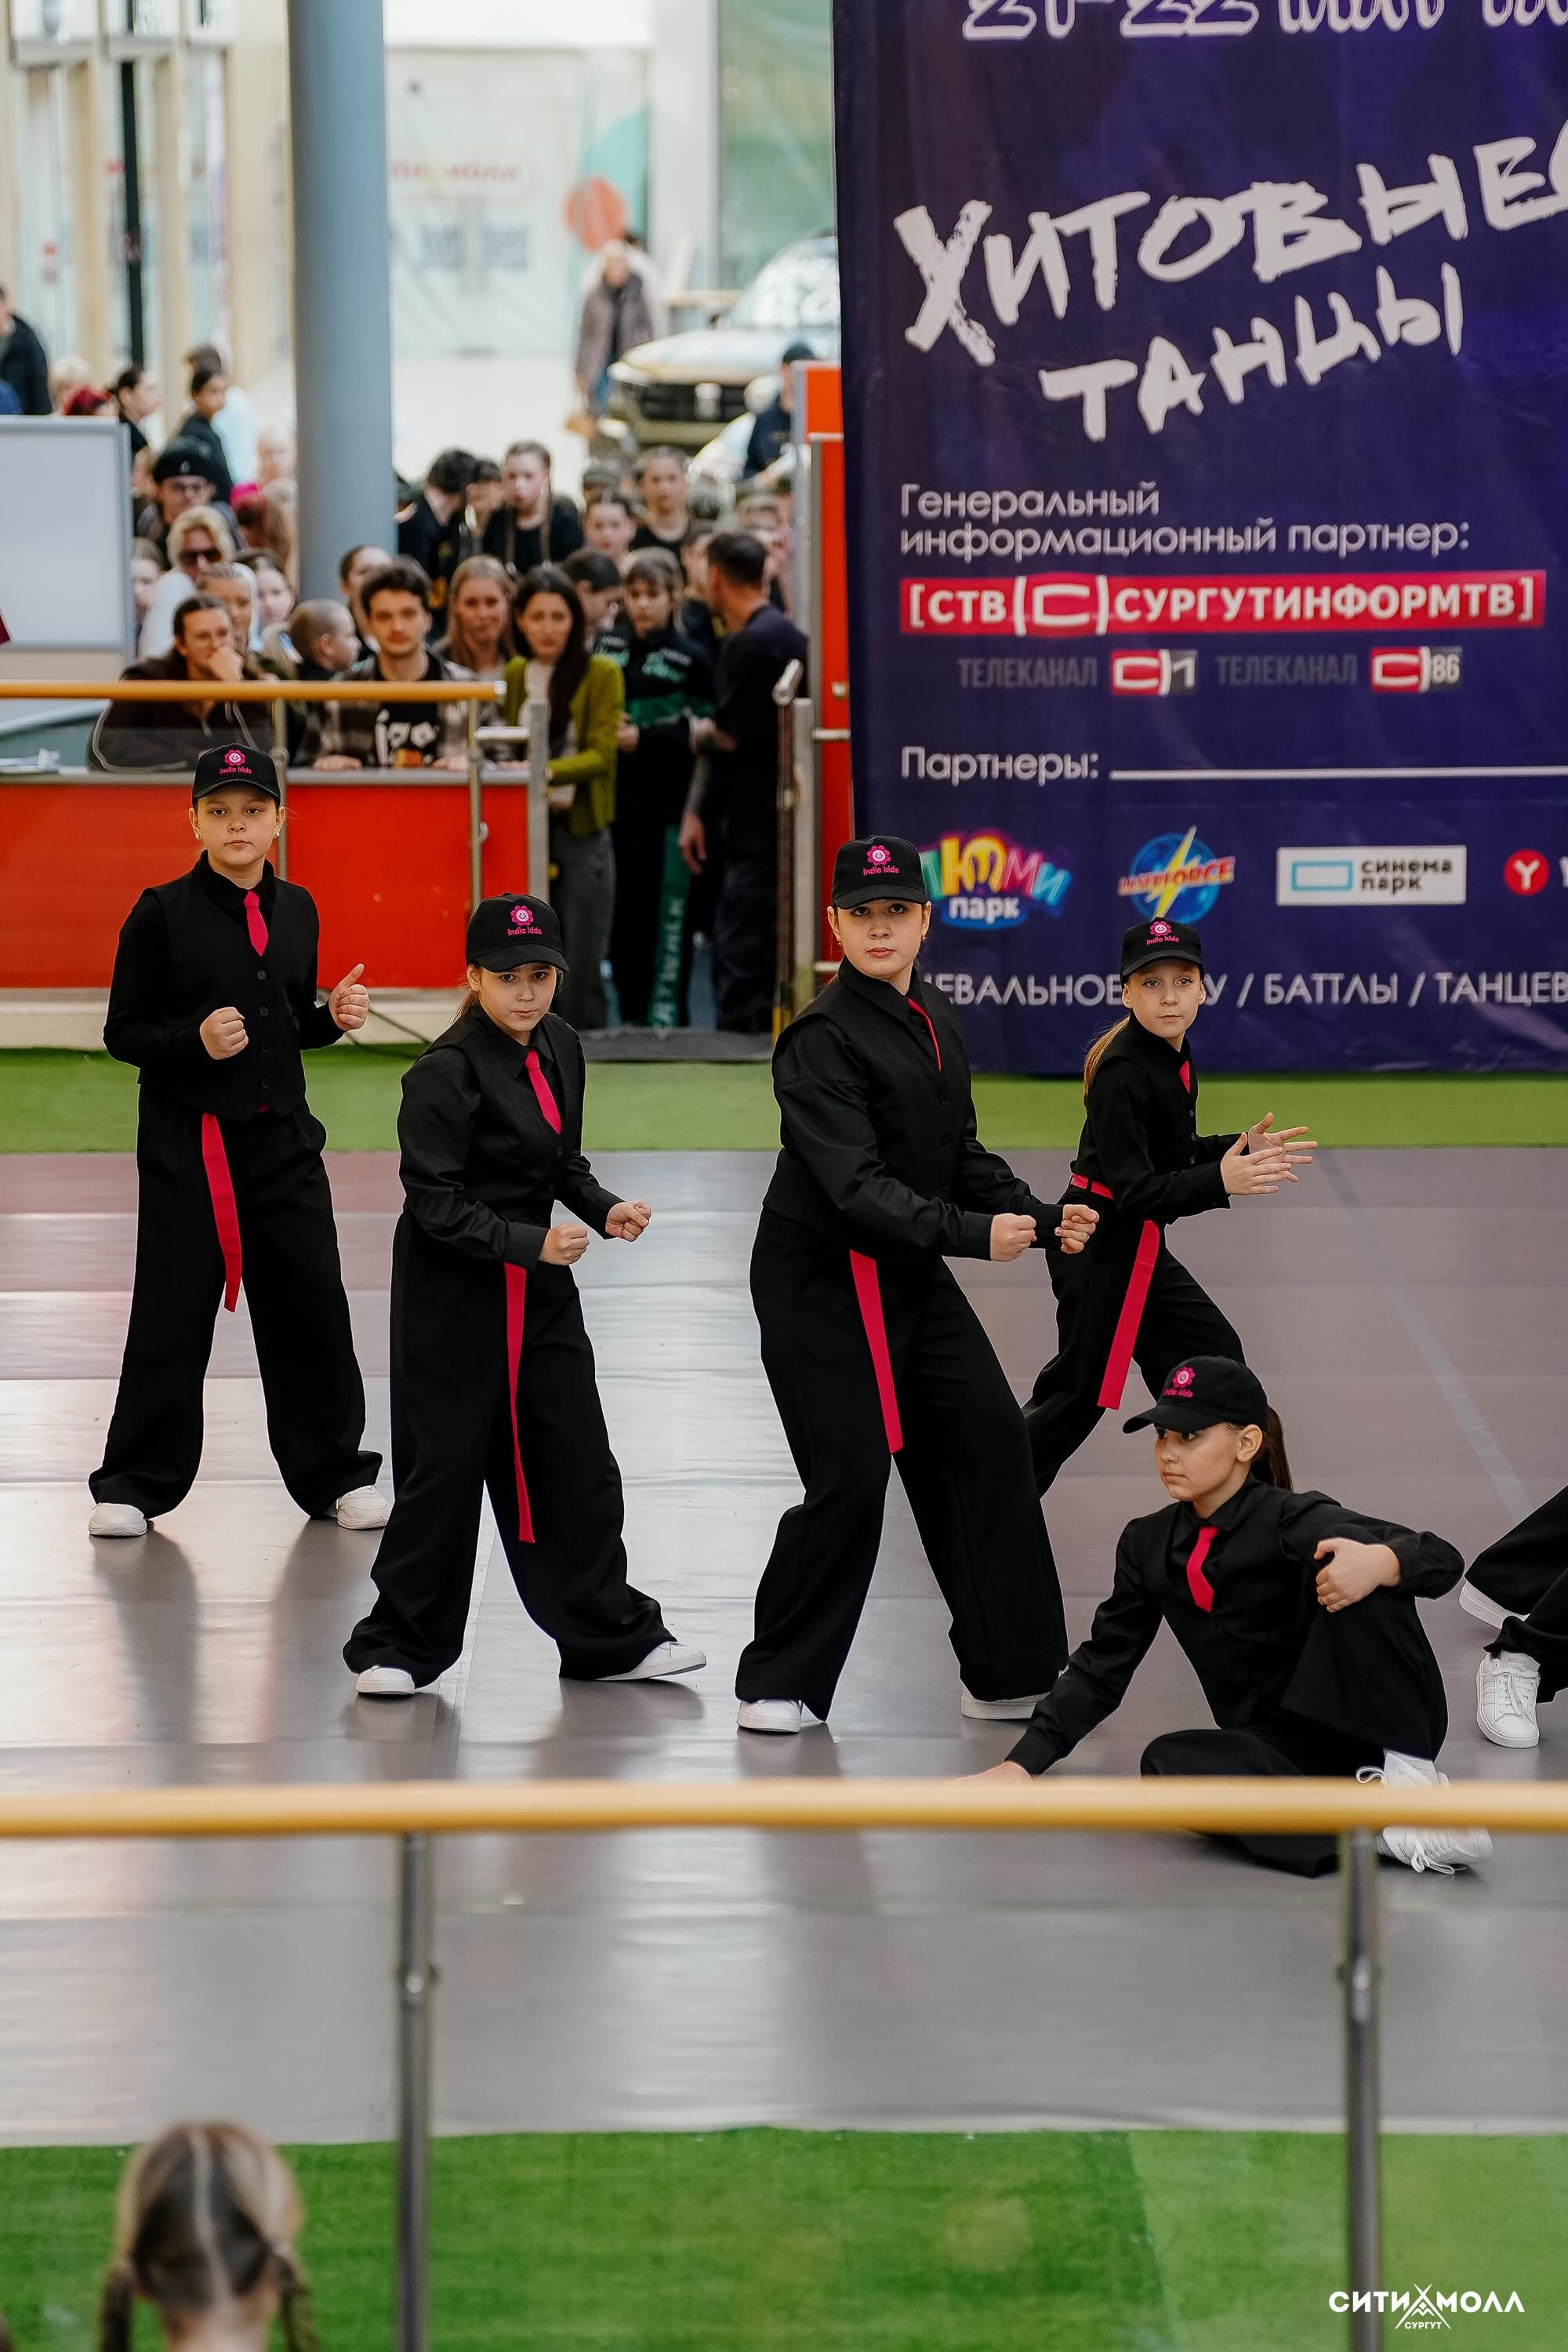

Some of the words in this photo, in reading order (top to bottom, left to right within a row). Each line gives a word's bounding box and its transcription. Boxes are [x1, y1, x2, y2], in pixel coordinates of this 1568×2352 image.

[894, 136, 1560, 367] ХИТОВЫЕ
[1039, 263, 1464, 441] ТАНЦЫ
[901, 481, 1160, 524] Генеральный
[901, 517, 1276, 564] информационный
[1287, 521, 1470, 559] партнер:
[957, 656, 1098, 688] ТЕЛЕКАНАЛ
[1217, 653, 1358, 686] ТЕЛЕКАНАЛ
[901, 746, 1099, 787] Партнеры:
[862, 866, 882, 876] indie
[883, 865, 899, 873] kids
[1362, 860, 1453, 873] синема
[1362, 877, 1421, 895] парк
[949, 896, 1020, 925] парк
[506, 927, 526, 936] indie
[527, 926, 543, 935] kids
[924, 972, 1123, 1006] ЕВАЛЬНОЕ
[1264, 972, 1399, 1006] БАТТЛЫ
